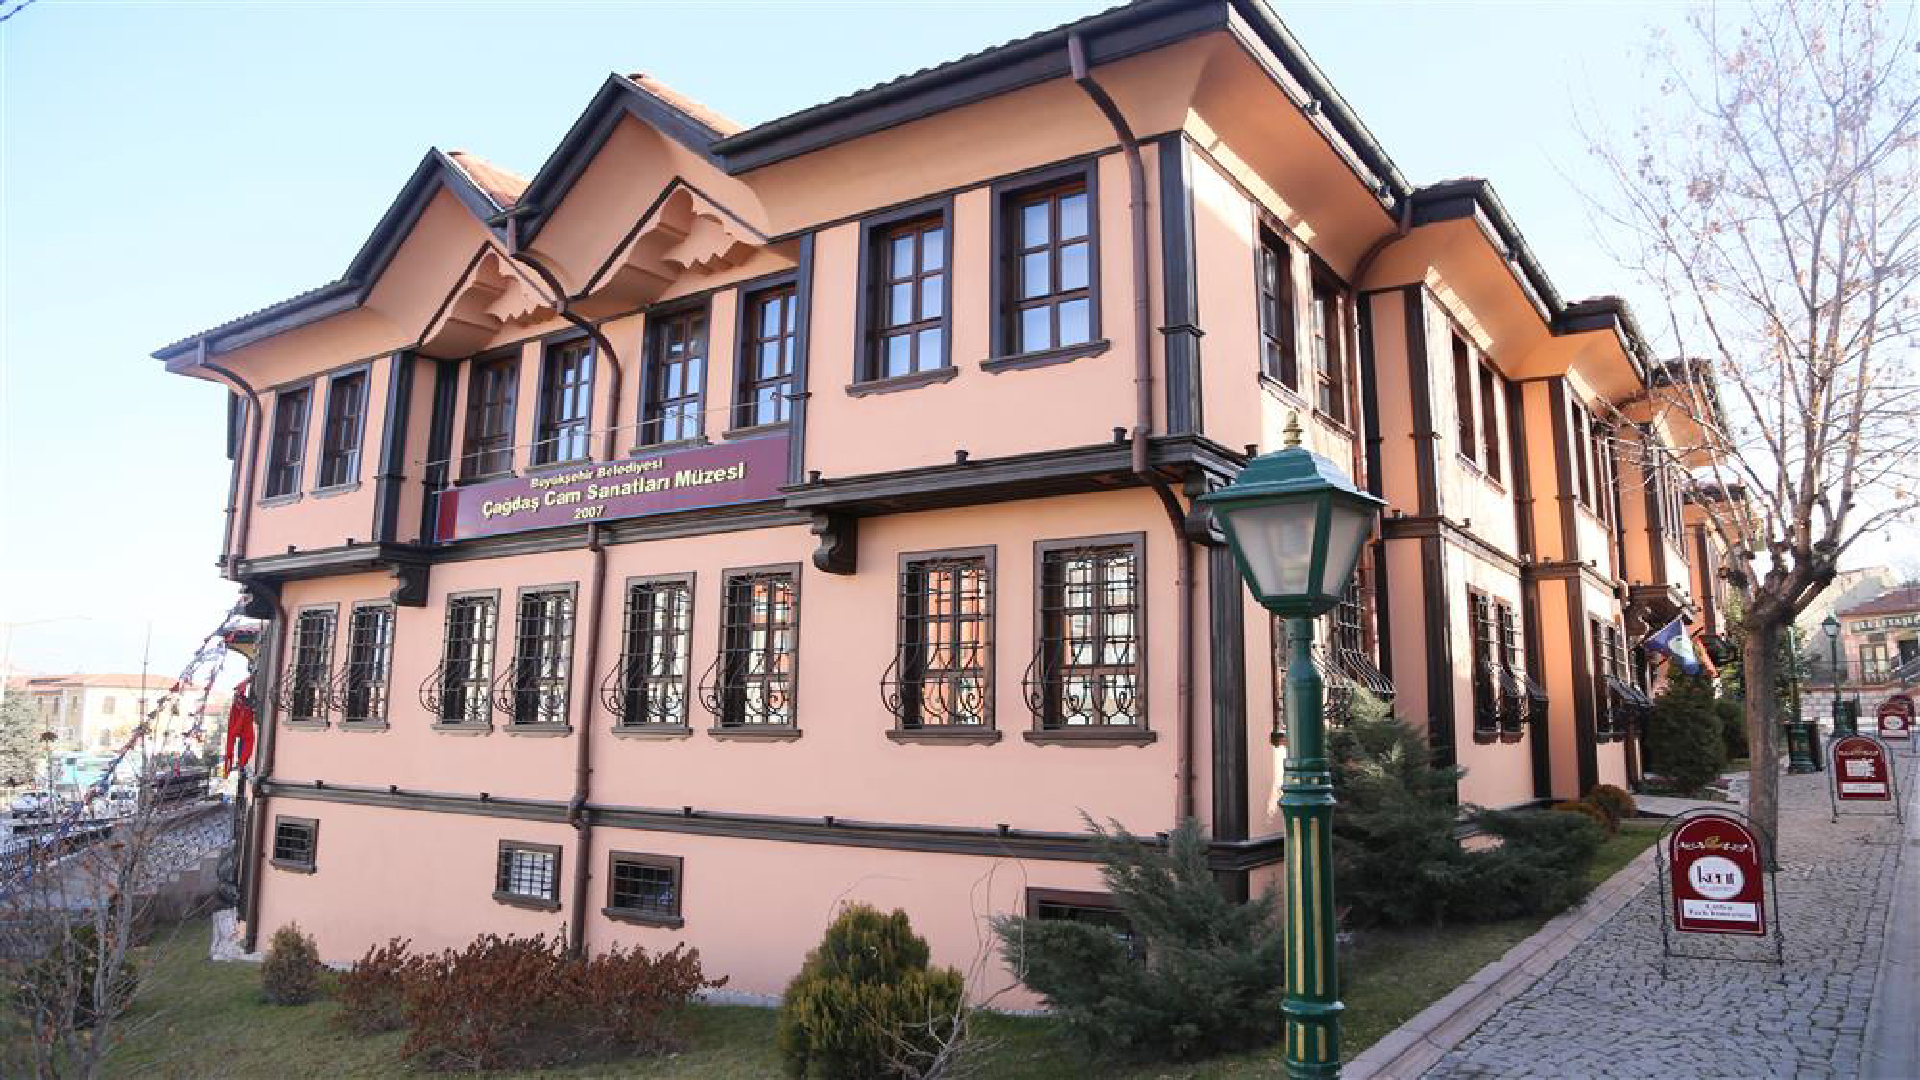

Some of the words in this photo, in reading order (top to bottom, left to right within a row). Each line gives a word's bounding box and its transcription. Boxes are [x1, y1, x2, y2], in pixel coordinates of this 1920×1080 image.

[597, 457, 663, 479] Belediyesi
[482, 495, 540, 519] Çağdaş
[545, 490, 582, 506] Cam
[587, 477, 671, 500] Sanatları
[675, 461, 744, 488] Müzesi
[574, 505, 605, 519] 2007
